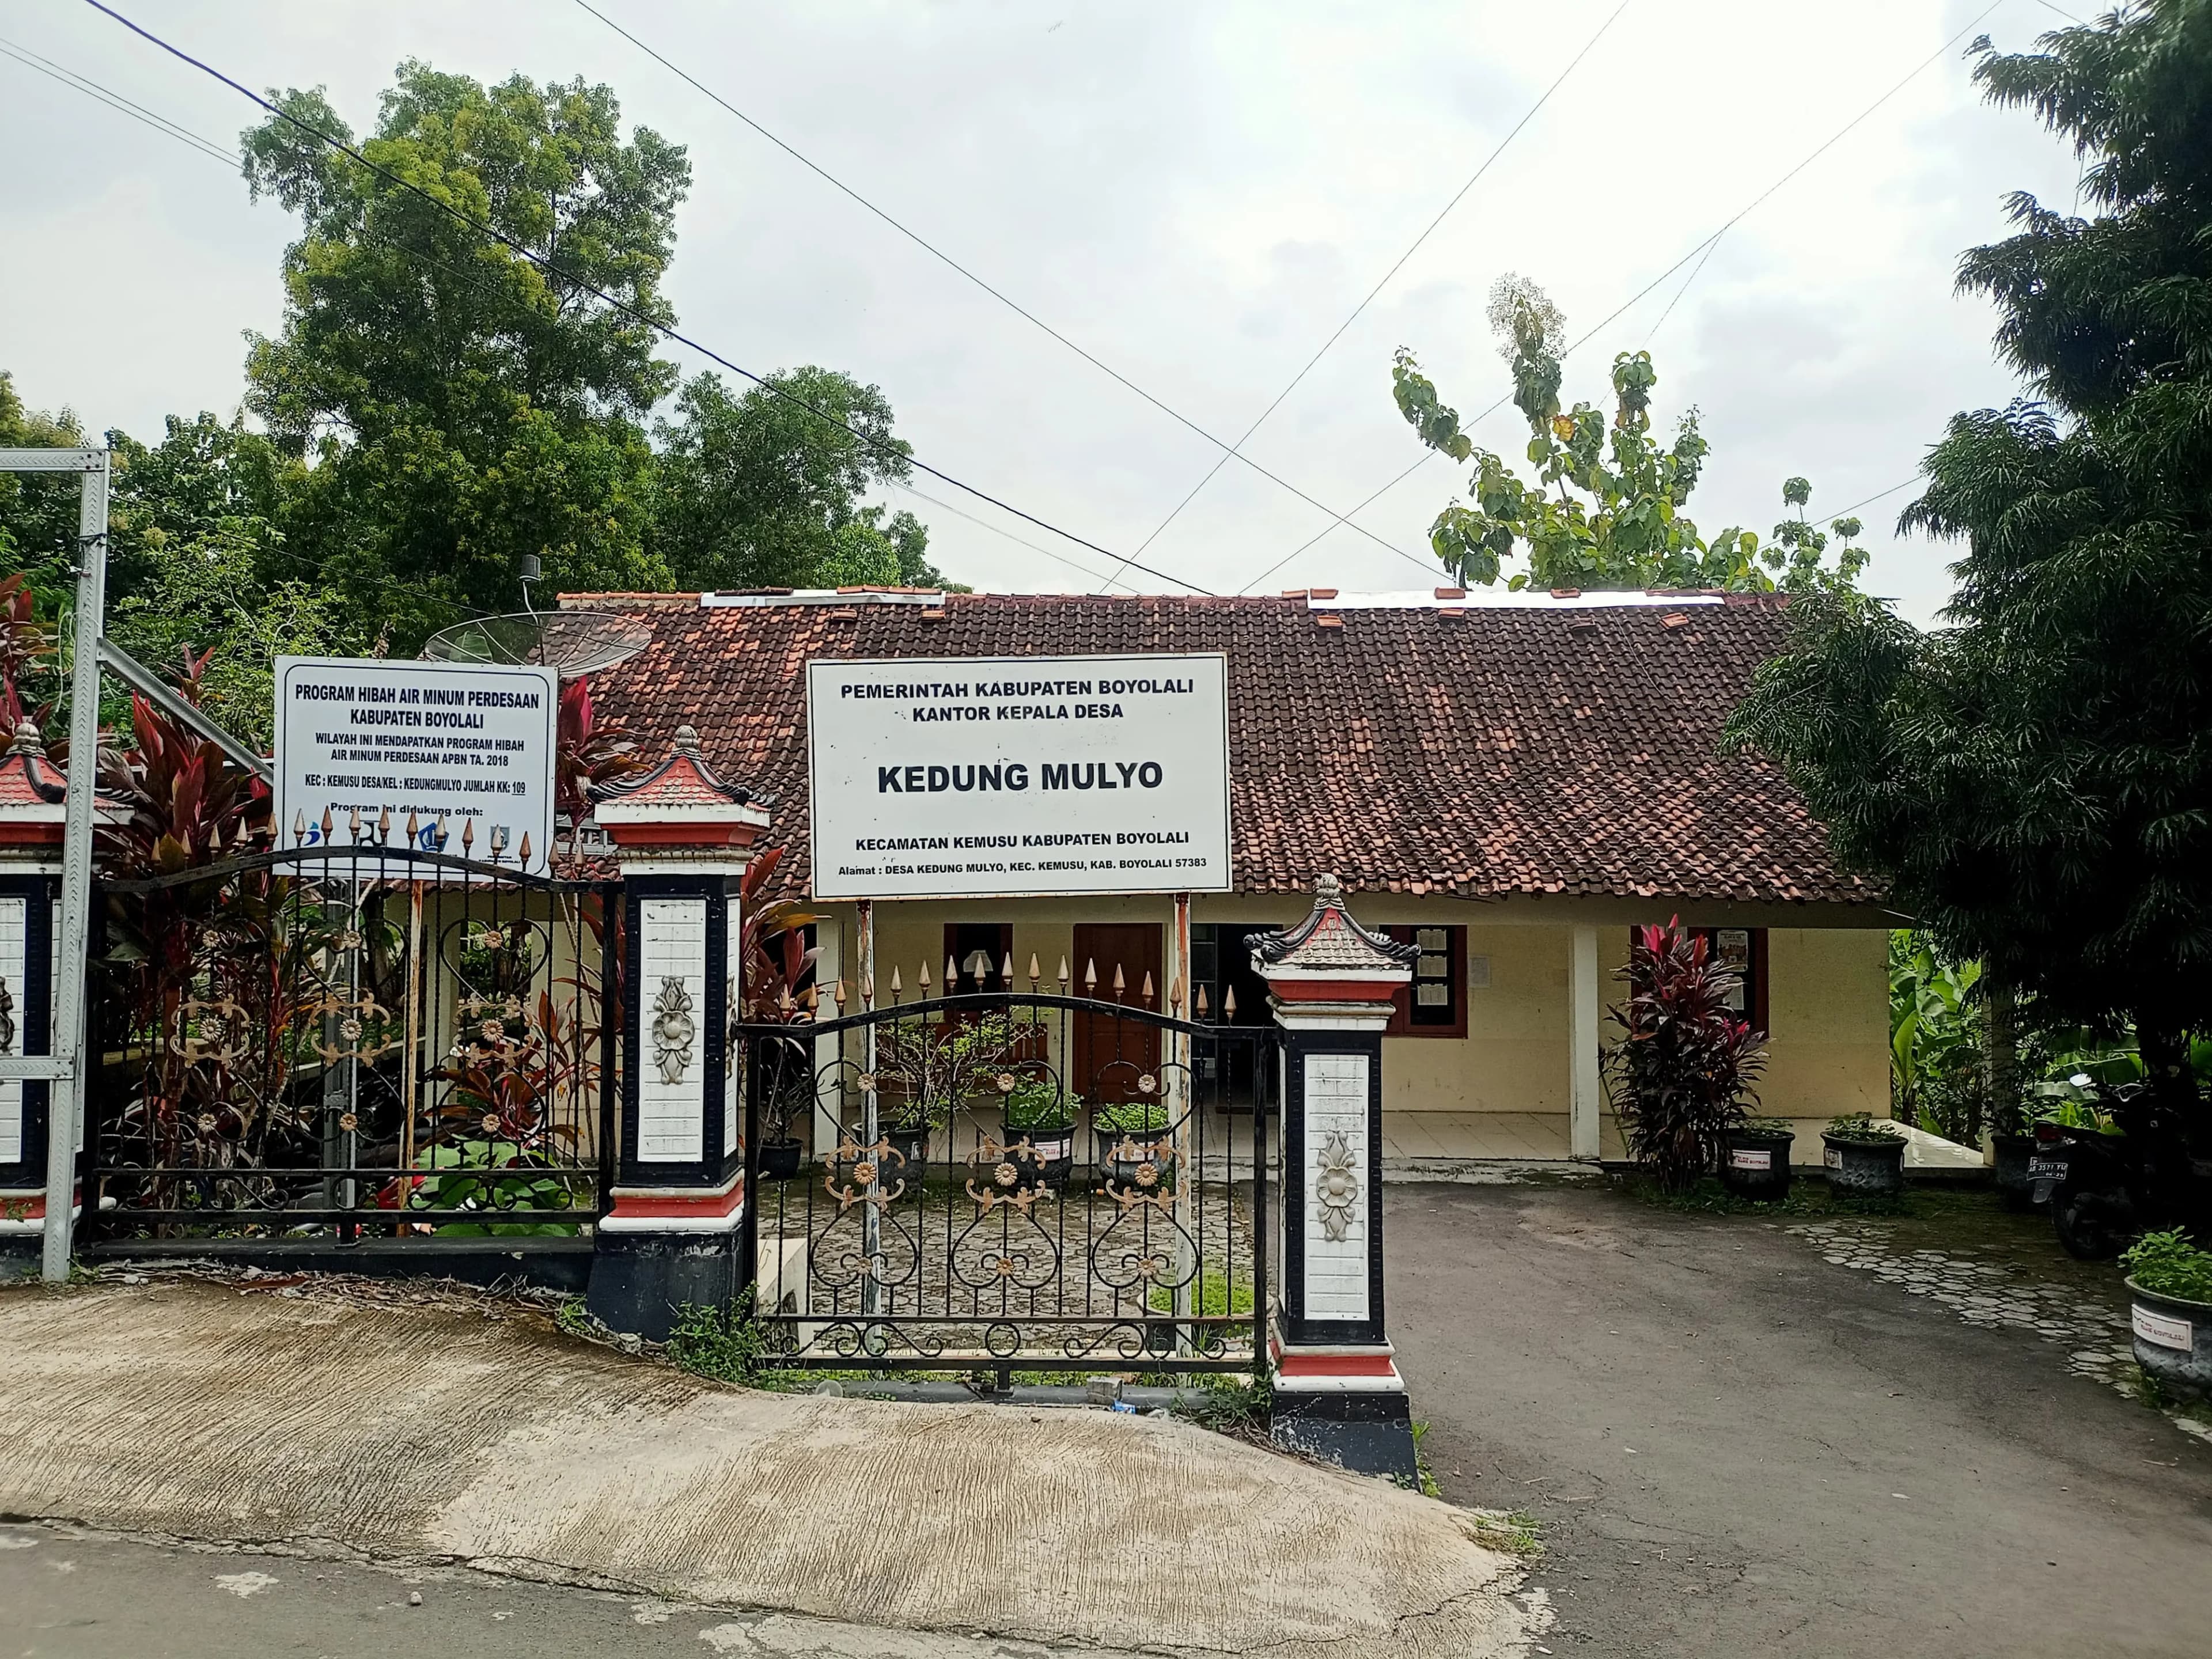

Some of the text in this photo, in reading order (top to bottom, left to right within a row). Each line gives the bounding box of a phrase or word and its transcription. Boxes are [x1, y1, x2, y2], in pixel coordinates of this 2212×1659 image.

[296, 684, 539, 709] PROGRAM HIBAH AIR MINUM PERDESAAN
[841, 679, 1193, 699] PEMERINTAH KABUPATEN BOYOLALI
[350, 709, 484, 729] KABUPATEN BOYOLALI
[913, 703, 1124, 722] KANTOR KEPALA DESA
[315, 732, 524, 752] WILAYAH INI MENDAPATKAN PROGRAM HIBAH
[331, 749, 509, 767] AIR MINUM PERDESAAN APBN TA. 2018
[305, 774, 321, 786] KEC
[327, 774, 360, 788] KEMUSU
[404, 777, 462, 791] KEDUNGMULYO
[463, 779, 495, 793] JUMLAH
[497, 781, 510, 793] KK:
[512, 781, 526, 794] 109
[878, 762, 1162, 793] KEDUNG MULYO
[330, 802, 379, 816] Program
[399, 805, 452, 817] didukung
[454, 806, 483, 816] oleh:
[856, 831, 1189, 851] KECAMATAN KEMUSU KABUPATEN BOYOLALI
[838, 865, 876, 876] Alamat
[885, 865, 914, 874] DESA
[917, 864, 963, 874] KEDUNG
[966, 863, 1006, 873] MULYO,
[1010, 862, 1035, 872] KEC.
[1038, 861, 1087, 872] KEMUSU,
[1090, 860, 1116, 869] KAB.
[1119, 859, 1172, 869] BOYOLALI
[1175, 858, 1207, 868] 57383
